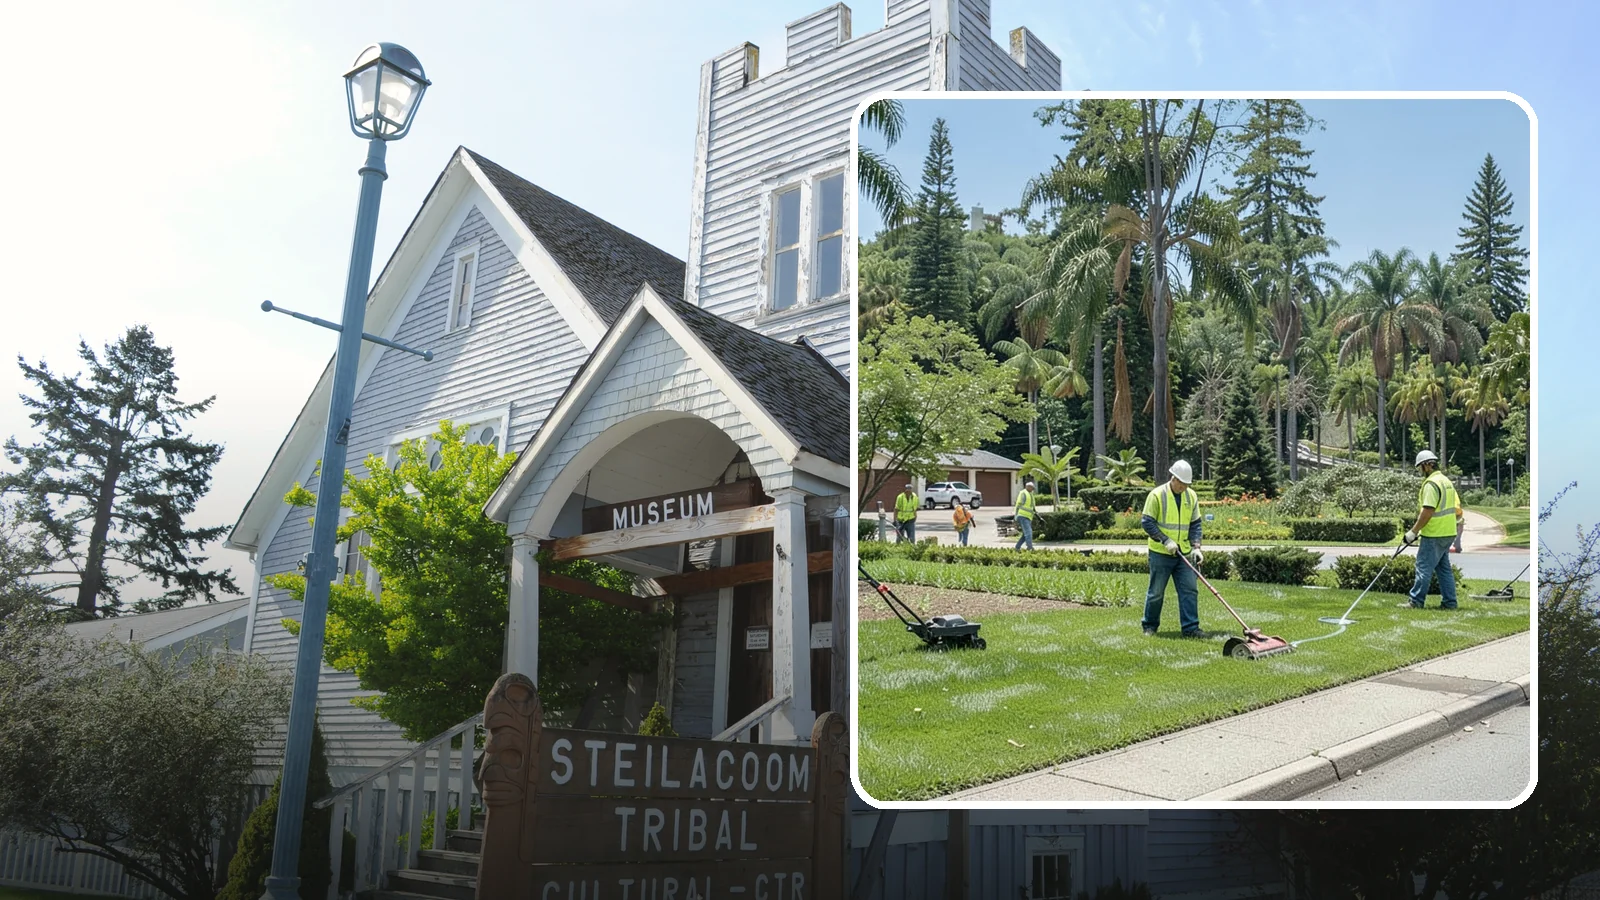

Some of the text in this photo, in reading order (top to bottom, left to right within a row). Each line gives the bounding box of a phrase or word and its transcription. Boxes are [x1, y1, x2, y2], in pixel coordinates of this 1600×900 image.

[613, 491, 714, 531] MUSEUM
[550, 738, 810, 793] STEILACOOM
[615, 807, 758, 852] TRIBAL
